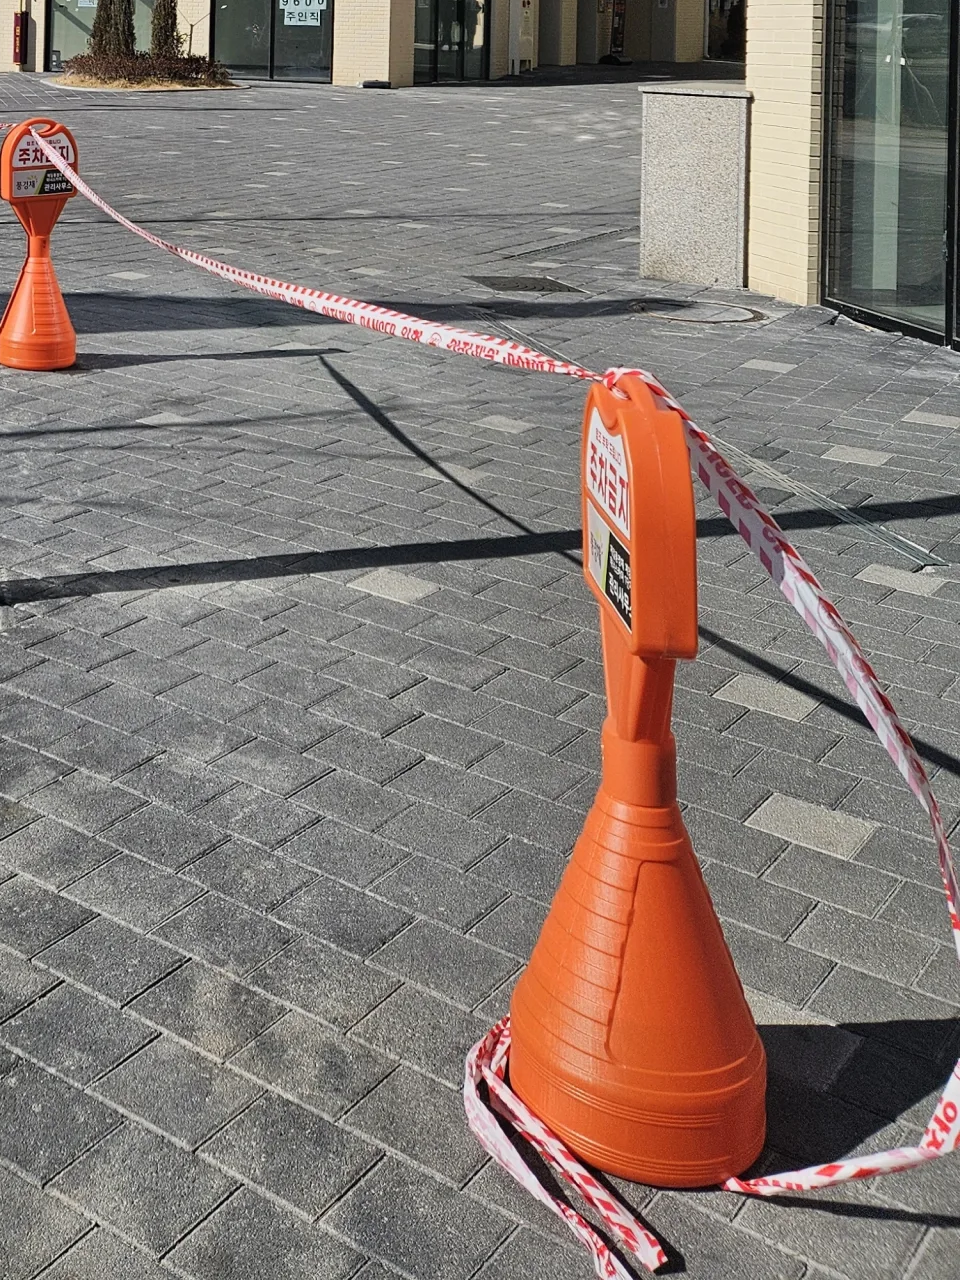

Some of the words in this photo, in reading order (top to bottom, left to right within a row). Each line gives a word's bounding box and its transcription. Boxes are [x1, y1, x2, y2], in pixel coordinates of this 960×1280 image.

[286, 11, 319, 22] 주인직
[15, 180, 36, 190] 풍경채
[44, 182, 72, 192] 관리사무소
[590, 440, 630, 531] 주차금지
